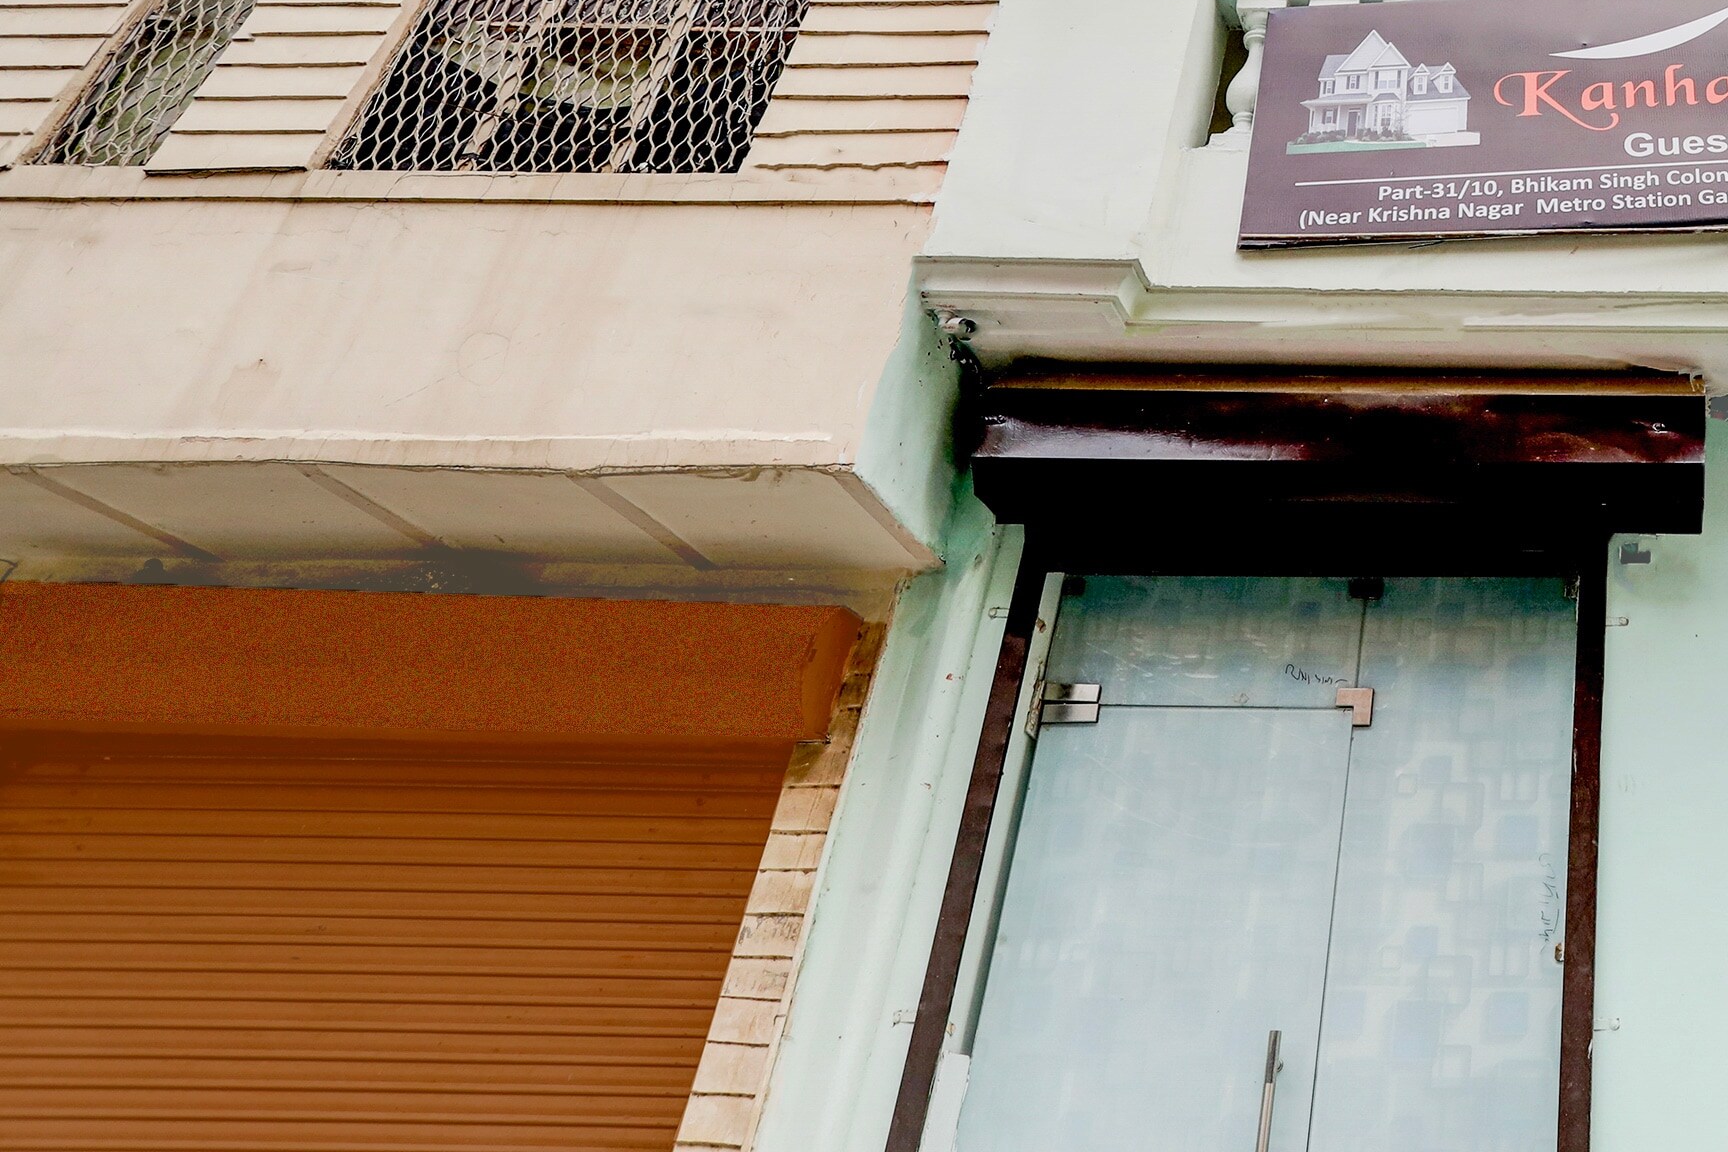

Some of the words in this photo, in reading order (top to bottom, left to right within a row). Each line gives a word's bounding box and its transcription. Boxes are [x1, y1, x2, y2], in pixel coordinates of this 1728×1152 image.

[1378, 179, 1503, 201] Part-31/10,
[1511, 176, 1593, 193] Bhikam
[1600, 171, 1659, 191] Singh
[1299, 209, 1361, 229] (Near
[1368, 204, 1450, 223] Krishna
[1458, 202, 1524, 220] Nagar
[1536, 196, 1606, 214] Metro
[1612, 192, 1691, 210] Station
